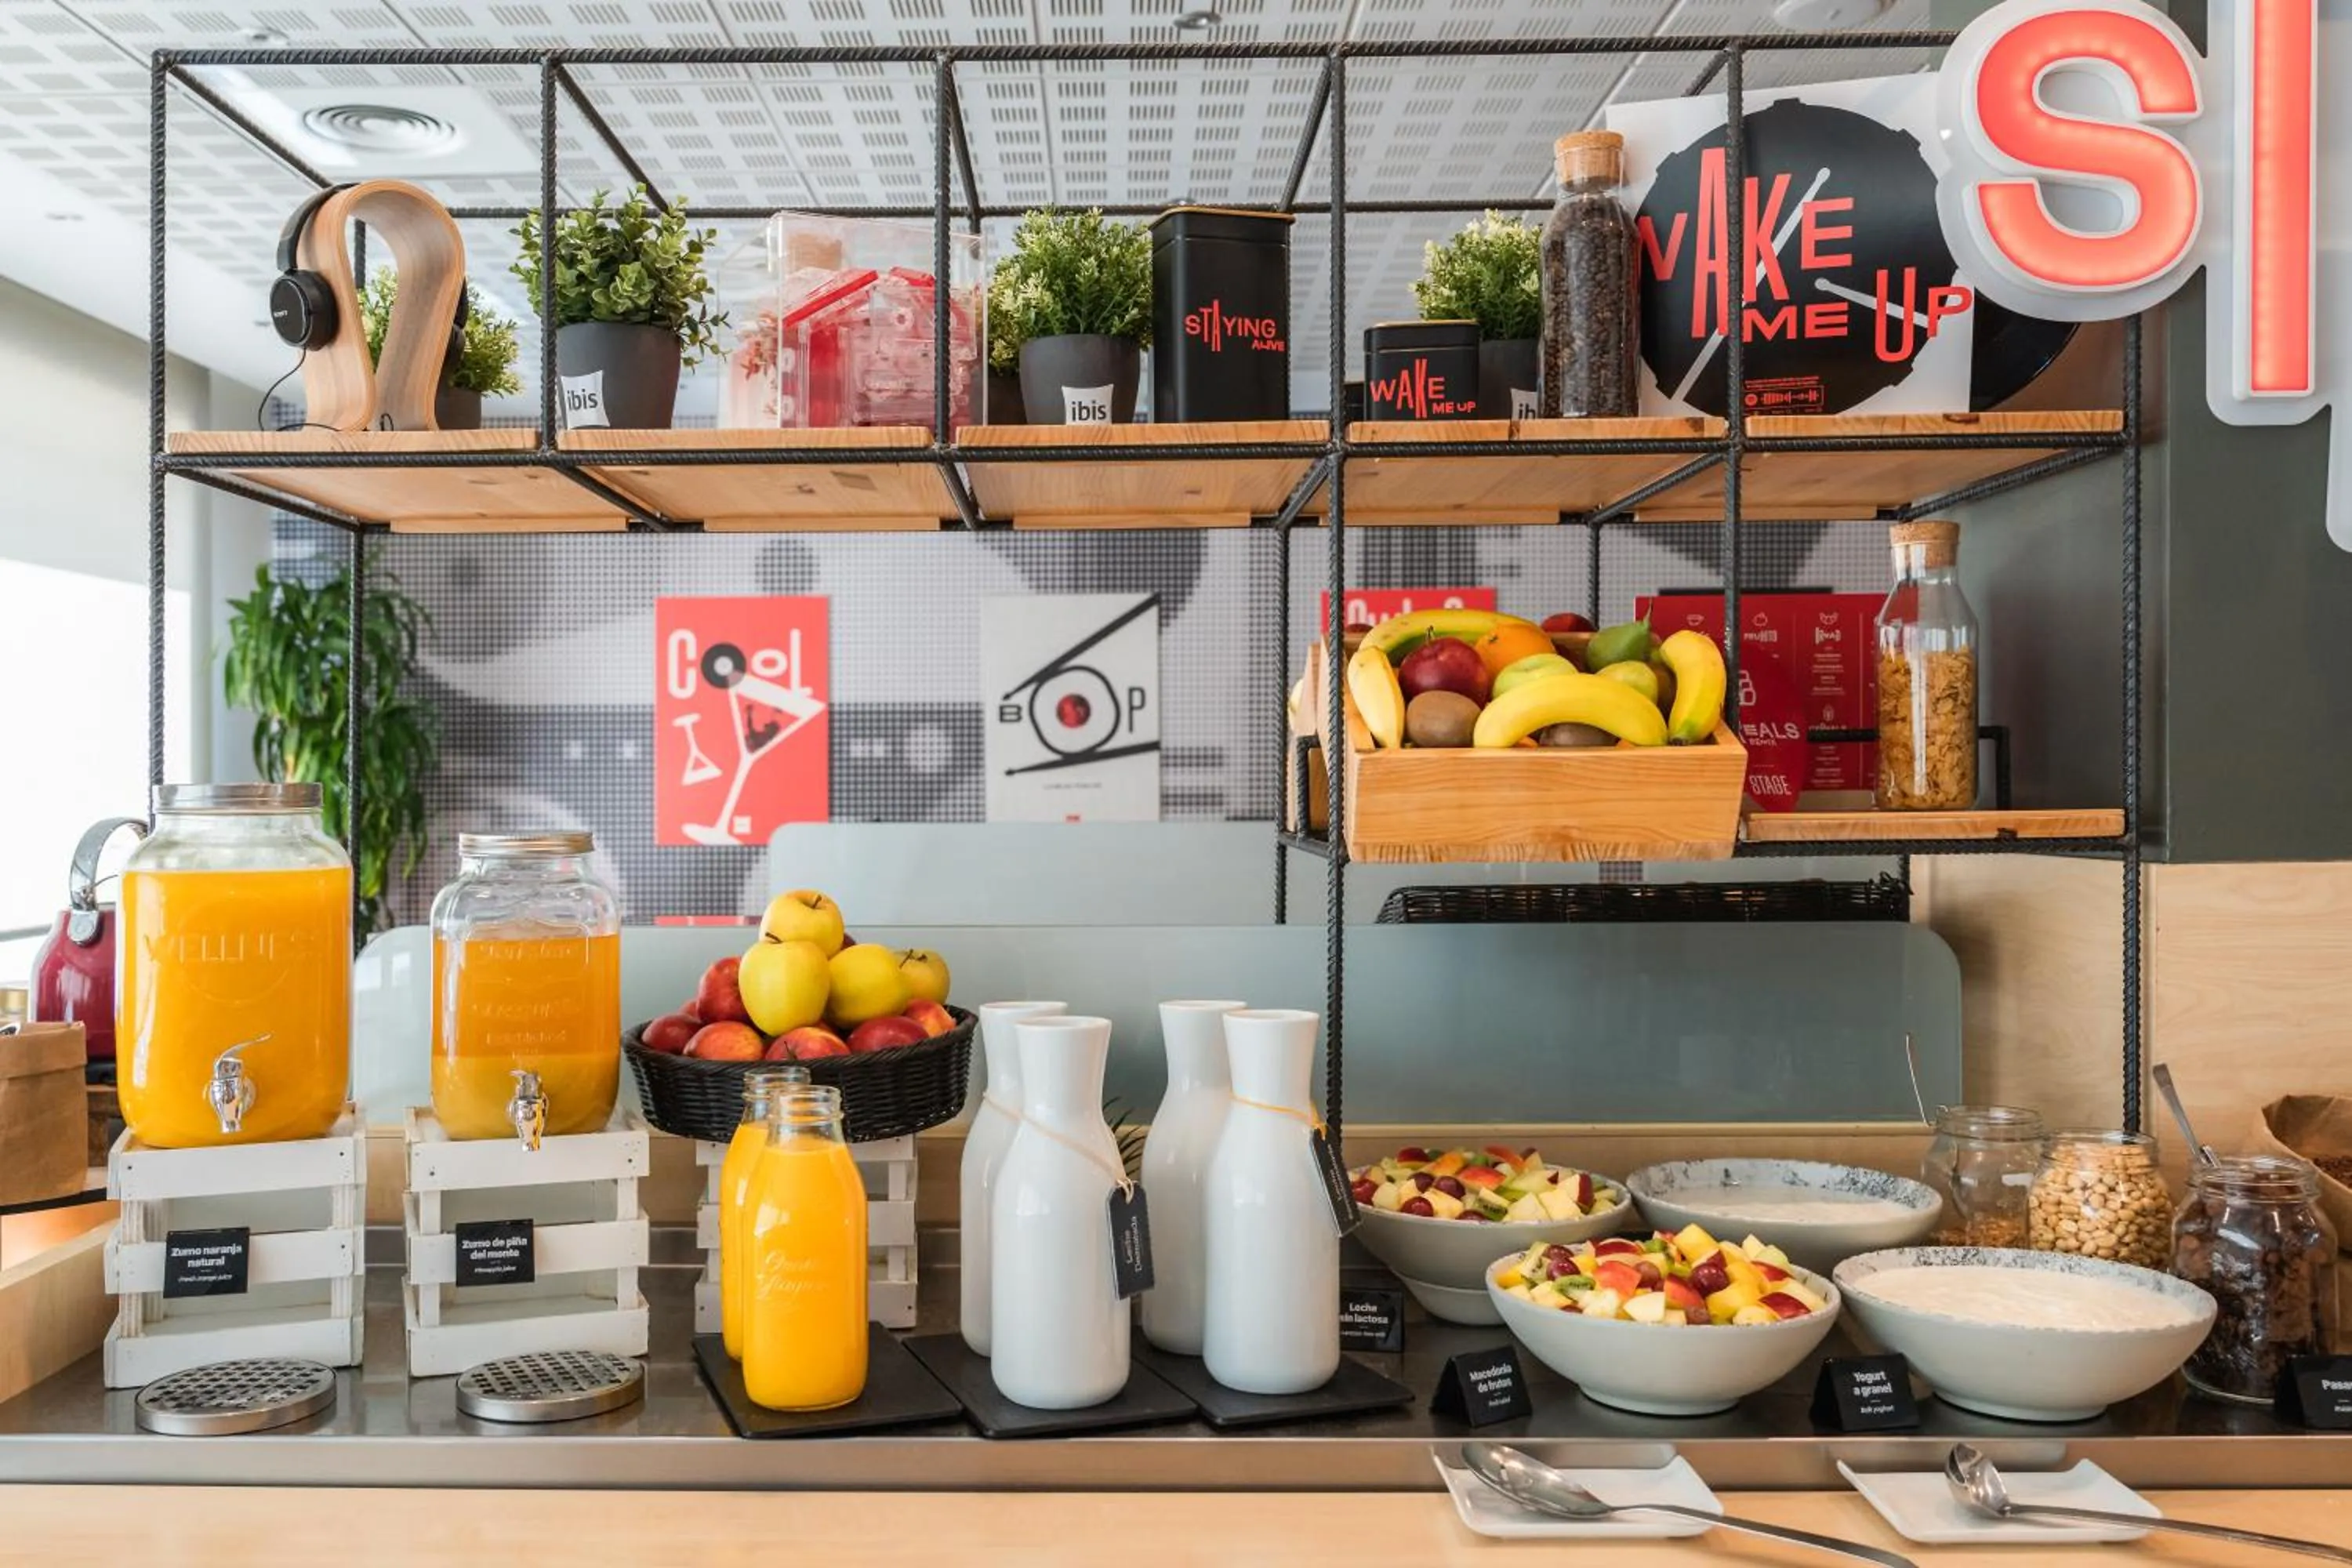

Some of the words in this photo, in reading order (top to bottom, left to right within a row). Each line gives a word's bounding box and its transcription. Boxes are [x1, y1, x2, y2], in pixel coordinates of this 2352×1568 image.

[1742, 301, 1849, 343] ME
[1875, 267, 1973, 362] UP
[1184, 299, 1276, 352] STAYING
[1370, 358, 1446, 419] WAKE
[567, 388, 598, 410] ibis
[1072, 399, 1106, 421] ibis
[1432, 401, 1454, 415] ME
[1457, 401, 1476, 413] UP
[170, 1247, 201, 1257] Zumo
[204, 1243, 242, 1255] naranja
[461, 1239, 491, 1249] Zumo
[492, 1237, 505, 1247] de
[187, 1255, 225, 1268] natural
[470, 1250, 486, 1260] del
[488, 1249, 520, 1258] monte
[1349, 1302, 1377, 1312] Leche
[1355, 1313, 1388, 1324] lactosa
[1469, 1363, 1512, 1381] Macedonia
[1853, 1371, 1886, 1385] Yogurt
[1861, 1382, 1893, 1398] granel
